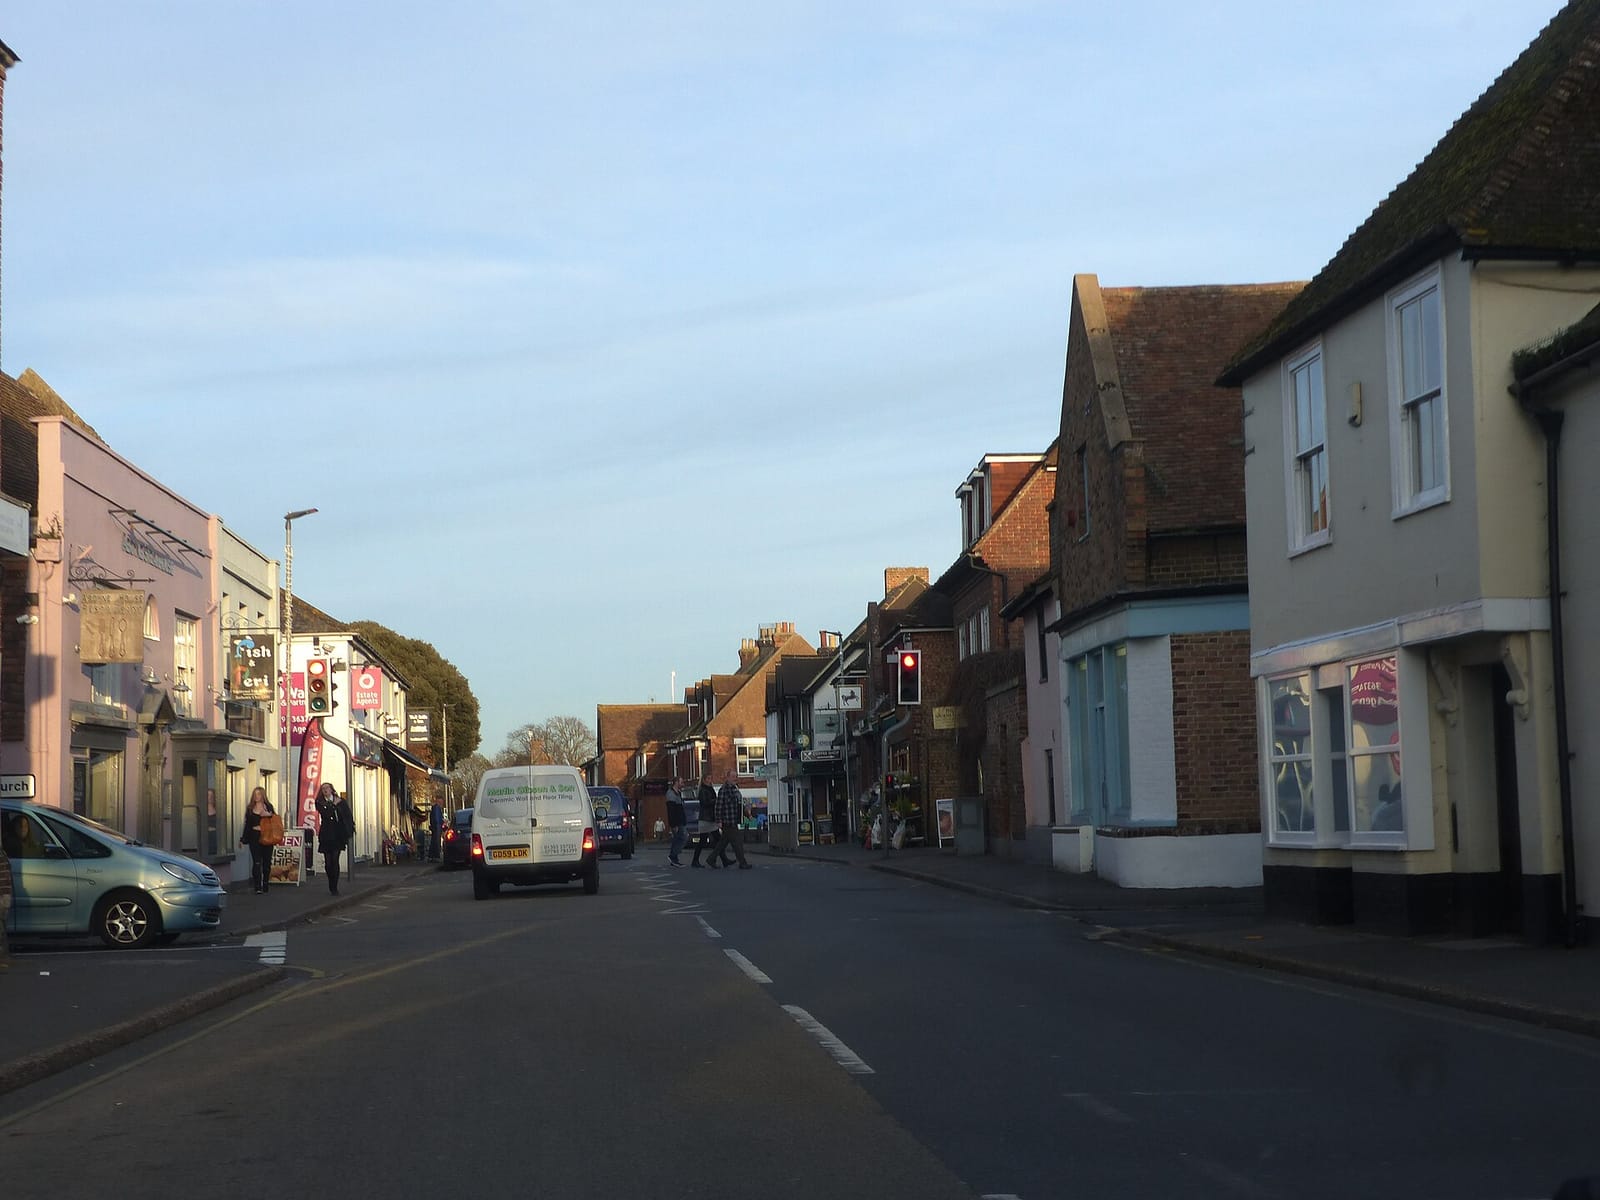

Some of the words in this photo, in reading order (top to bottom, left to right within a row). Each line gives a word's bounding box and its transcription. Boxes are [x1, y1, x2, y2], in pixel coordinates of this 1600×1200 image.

[234, 636, 271, 658] Fish
[248, 659, 256, 667] &
[356, 698, 379, 706] Agents
[292, 727, 307, 735] Age
[0, 780, 29, 791] urch
[273, 849, 293, 858] ISH
[273, 857, 300, 866] HIPS
